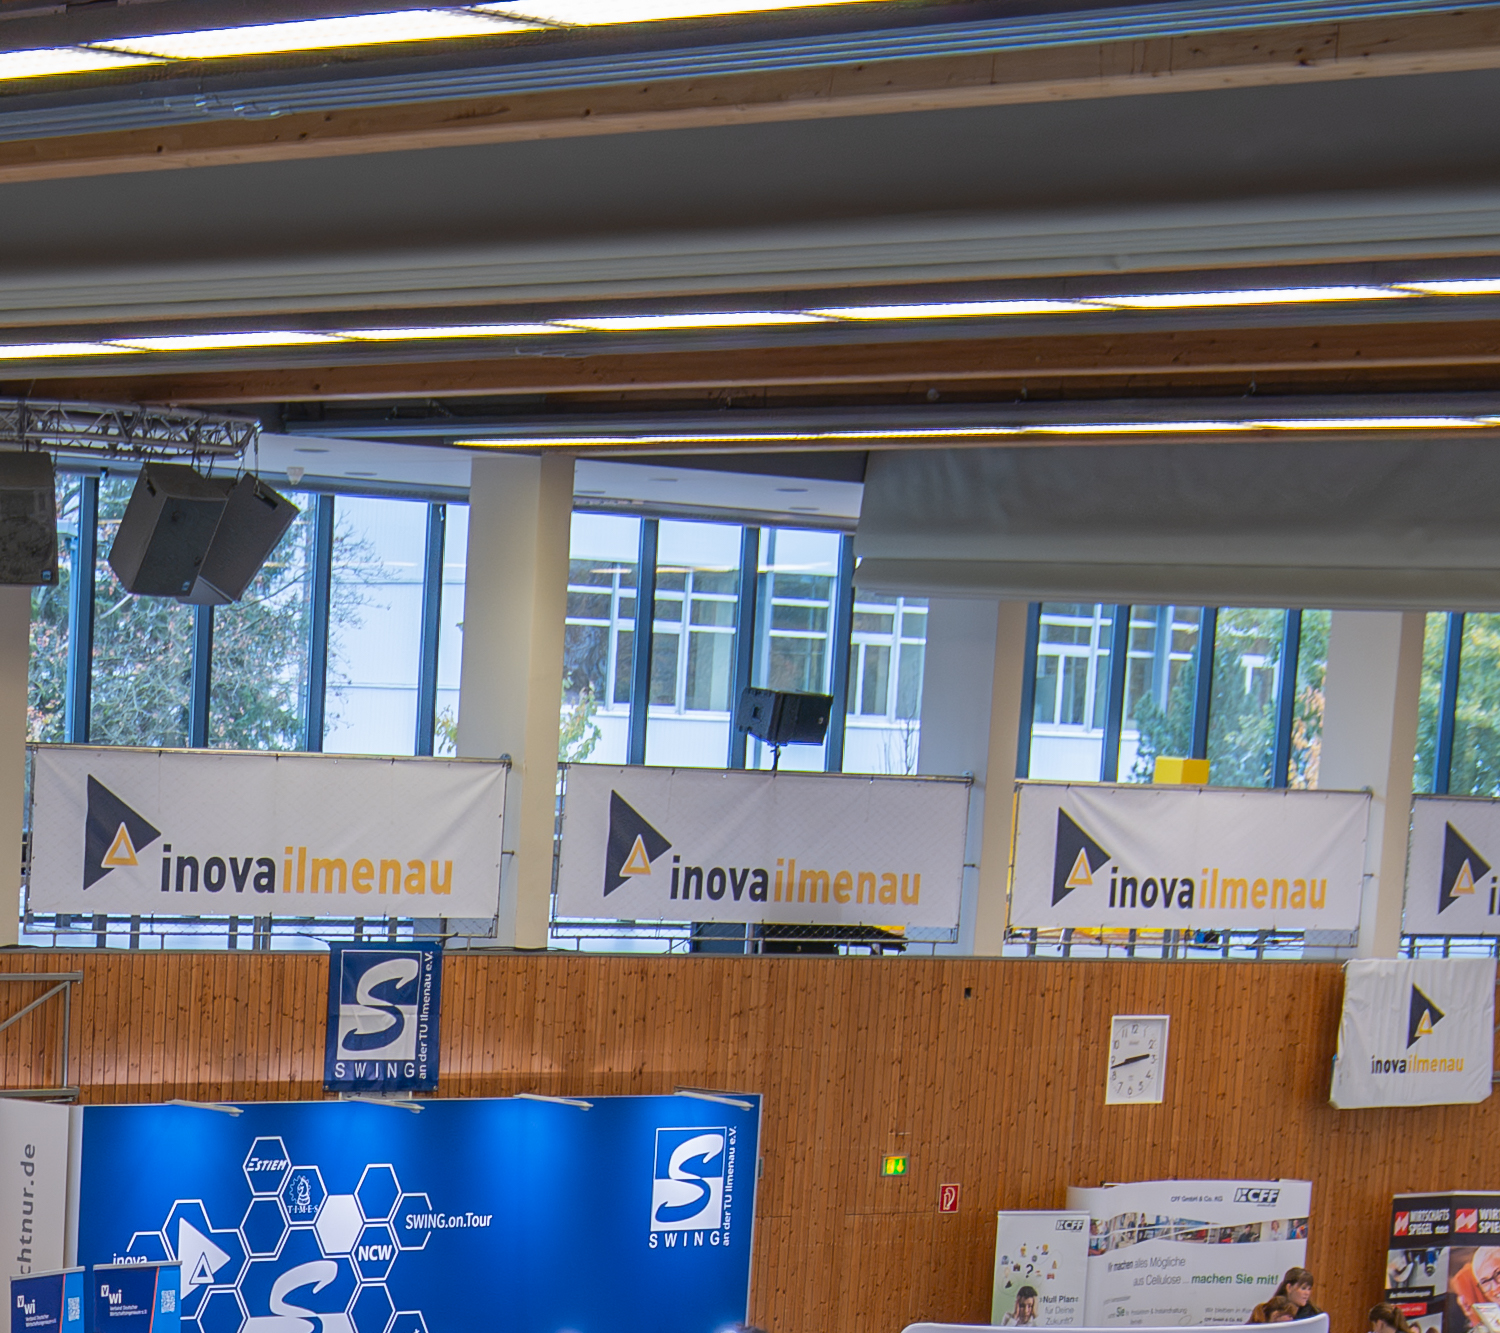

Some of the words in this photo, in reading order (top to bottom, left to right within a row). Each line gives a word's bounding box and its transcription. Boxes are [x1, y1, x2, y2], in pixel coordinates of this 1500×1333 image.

[160, 844, 453, 896] inovailmenau
[670, 855, 921, 906] inovailmenau
[1109, 867, 1327, 911] inovailmenau
[420, 974, 432, 1021] Ilmenau
[335, 1062, 415, 1079] SWING
[1370, 1054, 1465, 1075] inovailmenau
[247, 1158, 287, 1171] ESTIEM
[726, 1146, 736, 1192] Ilmenau
[19, 1143, 36, 1274] chtnur.de
[405, 1212, 492, 1229] SWING.on.Tour
[649, 1230, 720, 1249] SWING
[358, 1245, 393, 1261] NCW
[1191, 1274, 1232, 1284] machen
[1235, 1274, 1253, 1284] Sie
[1256, 1274, 1279, 1285] mit!
